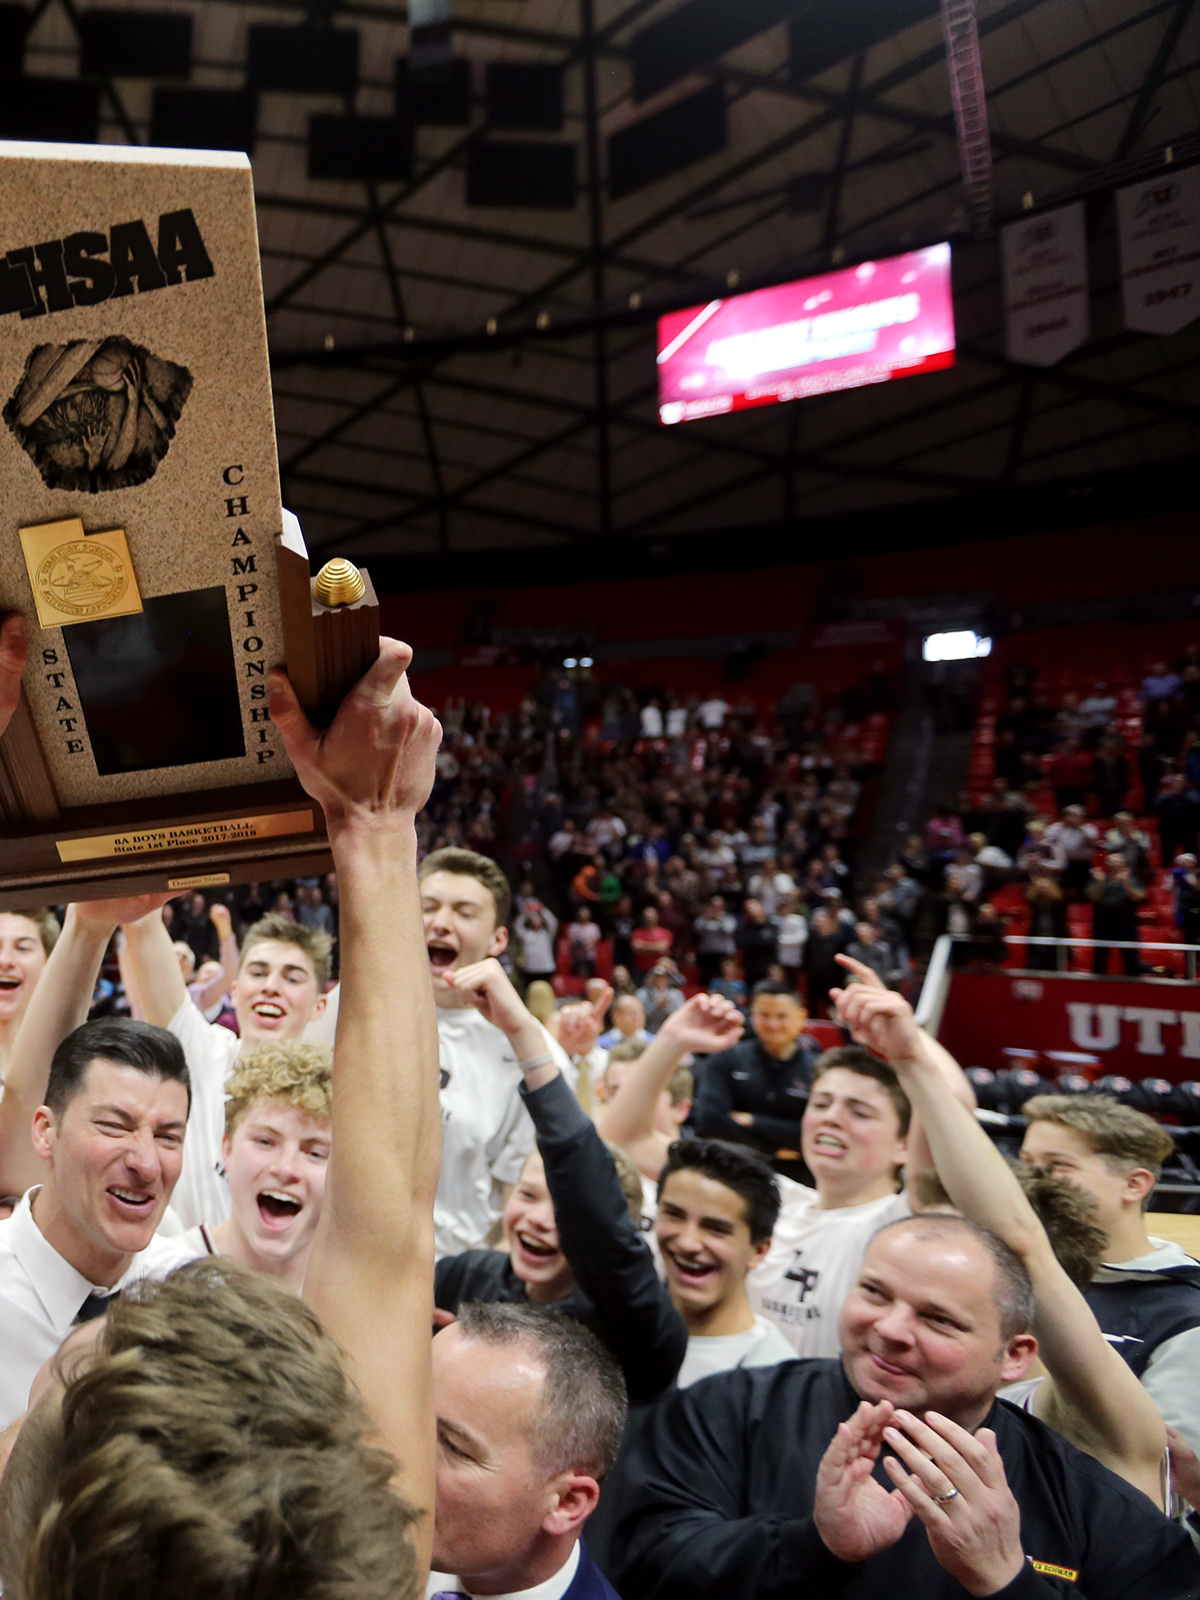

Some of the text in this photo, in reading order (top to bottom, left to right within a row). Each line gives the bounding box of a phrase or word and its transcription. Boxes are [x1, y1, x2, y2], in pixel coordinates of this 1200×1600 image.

[222, 464, 275, 765] CHAMPIONSHIP
[42, 648, 84, 755] STATE
[114, 829, 257, 854] State 1st Place 2017-2018
[133, 832, 166, 843] BOYS
[169, 821, 254, 839] BASKETBALL
